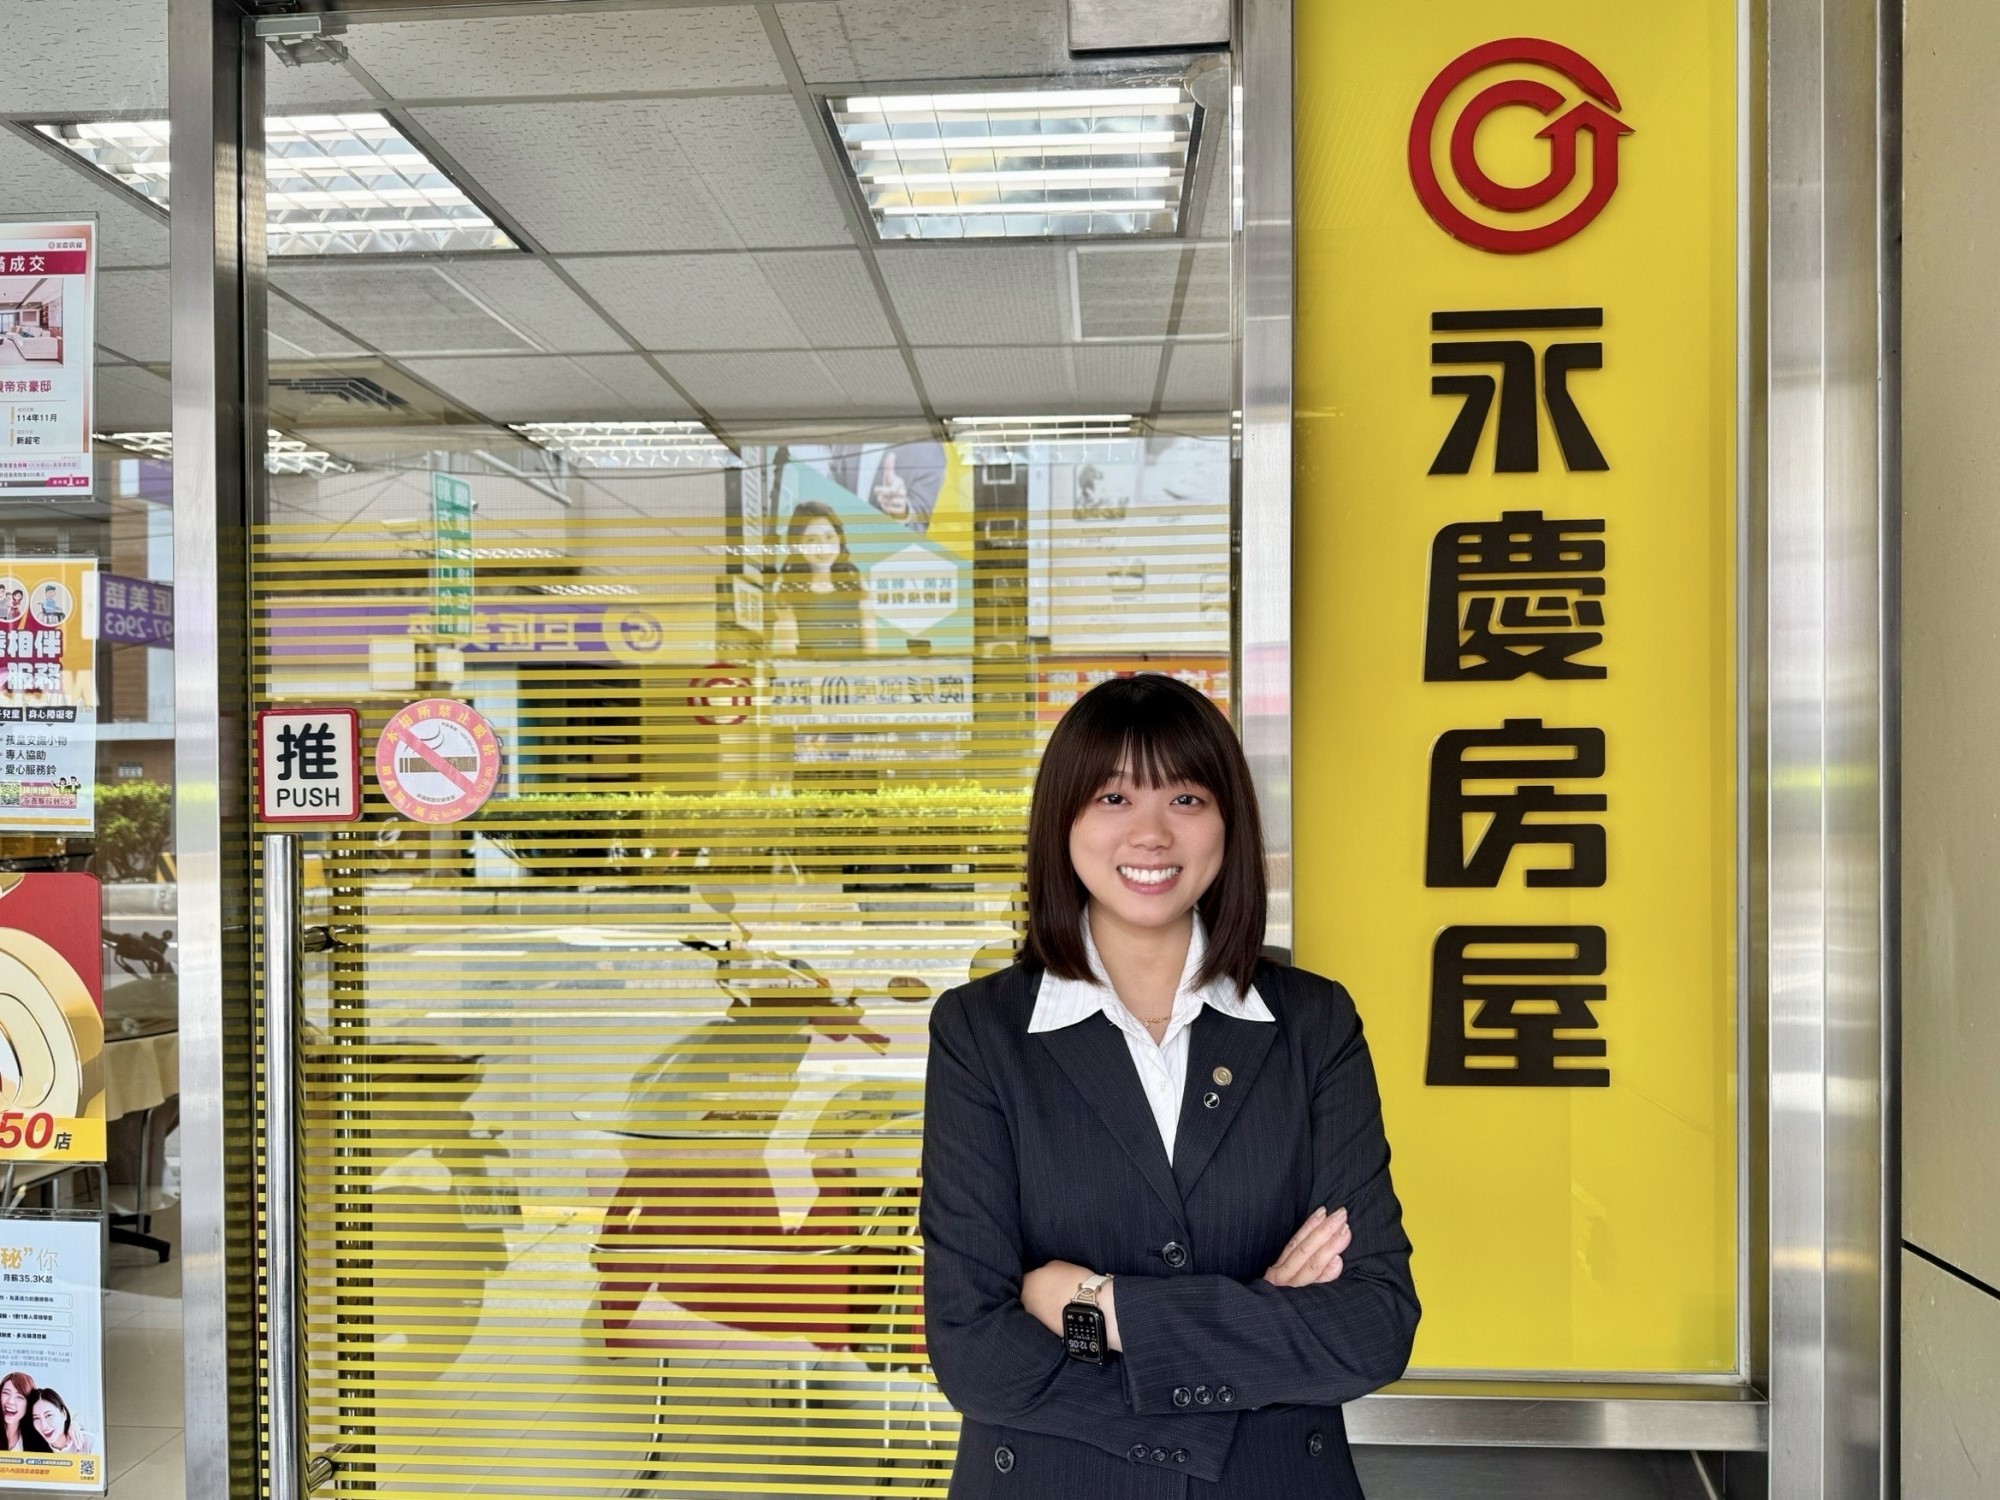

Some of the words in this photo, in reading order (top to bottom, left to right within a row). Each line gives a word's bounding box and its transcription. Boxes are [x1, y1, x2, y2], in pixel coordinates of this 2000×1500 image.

[16, 413, 58, 423] 114年11月
[0, 630, 62, 658] 相伴
[7, 662, 62, 690] 服務
[1426, 308, 1610, 1087] 永慶房屋
[5, 750, 47, 761] 專人協助
[276, 721, 339, 781] 推
[5, 765, 57, 776] 愛心服務鈴
[277, 787, 340, 807] PUSH
[3, 1274, 54, 1284] 月薪35.3K起
[1069, 1341, 1088, 1350] 12:05
